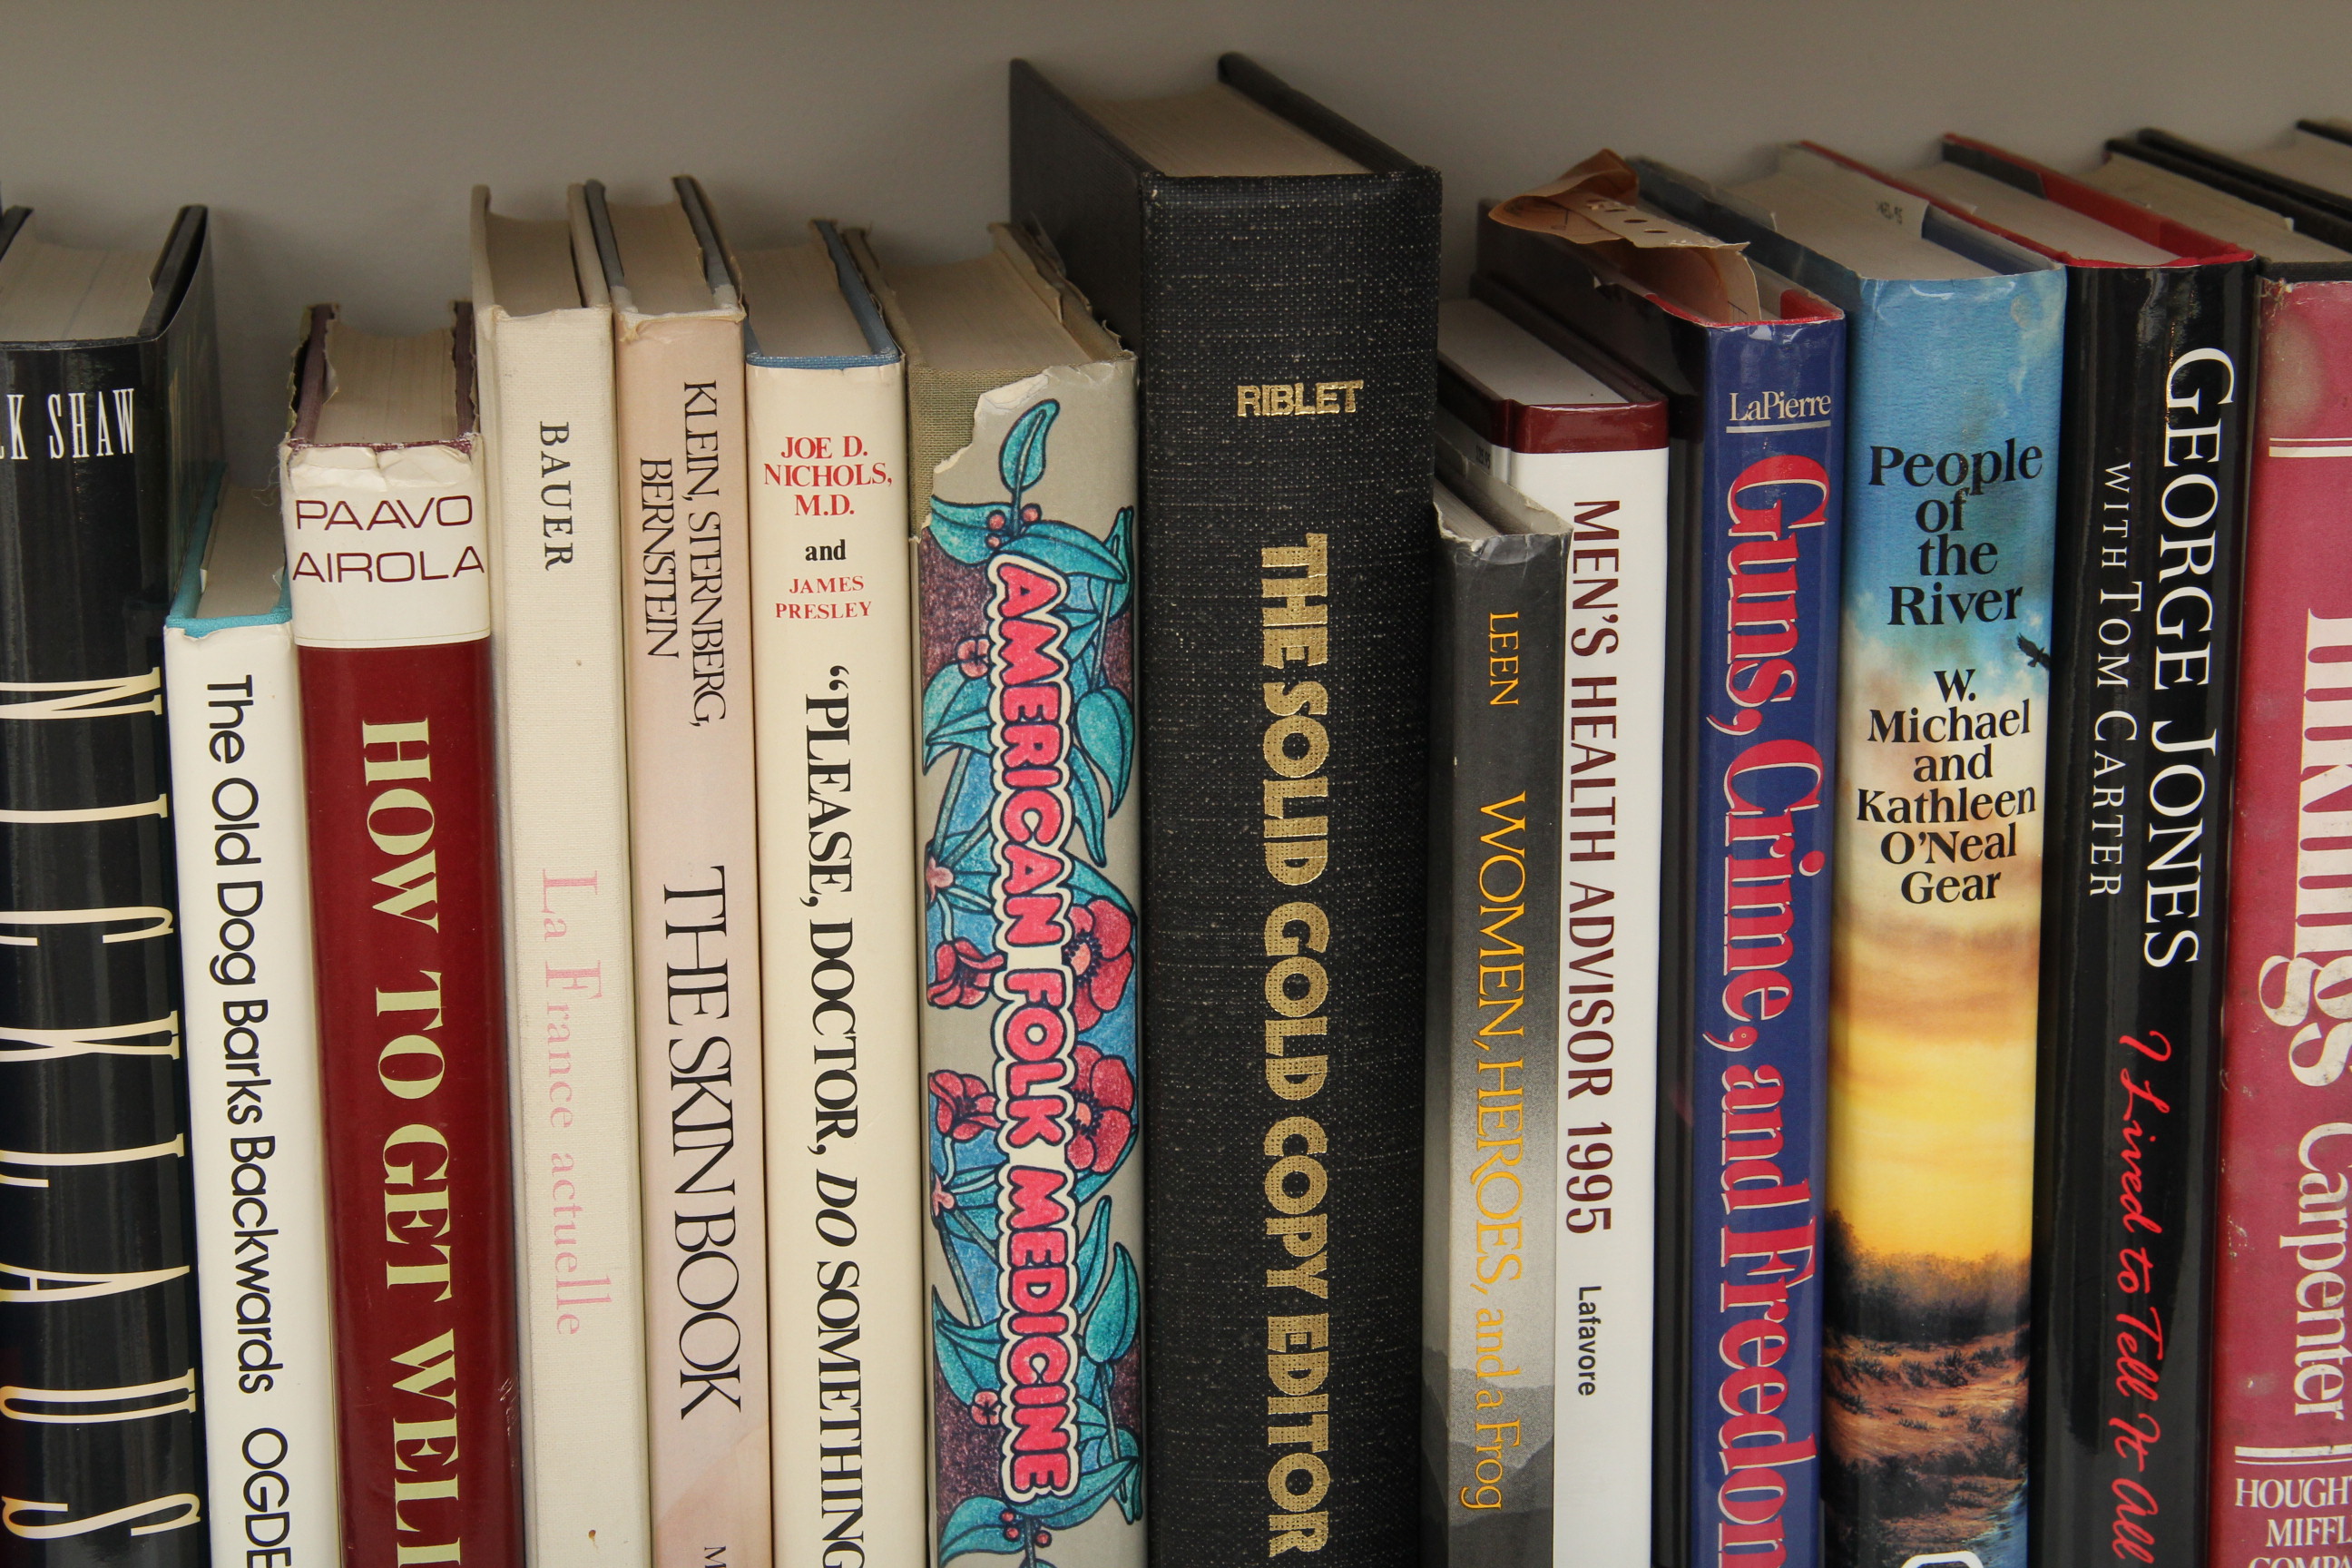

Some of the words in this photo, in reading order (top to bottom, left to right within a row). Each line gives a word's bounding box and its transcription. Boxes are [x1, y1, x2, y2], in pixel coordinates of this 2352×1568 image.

[0, 395, 28, 459] K
[48, 388, 133, 458] SHAW
[682, 381, 719, 501] KLEIN,
[781, 437, 832, 459] JOE
[844, 436, 867, 457] D.
[1238, 380, 1364, 417] RIBLET
[1730, 391, 1830, 421] LaPierre
[296, 495, 472, 530] PAAVO
[540, 421, 573, 571] BAUER
[765, 465, 892, 486] NICHOLS,
[796, 495, 855, 515] M.D.
[1868, 438, 2042, 495] People
[1916, 487, 1970, 533] of
[2102, 463, 2131, 567] WITH
[2155, 348, 2234, 690] GEORGE
[292, 546, 485, 583] AIROLA
[641, 458, 679, 658] BERNSTEIN
[789, 578, 864, 593] JAMES
[806, 539, 846, 561] and
[1261, 533, 1328, 669] THE
[1571, 501, 1620, 656] MEN’S
[1706, 454, 1830, 736] Guns,
[1887, 582, 2023, 625] River
[1918, 534, 1997, 575] the
[689, 512, 726, 726] STERNBERG,
[776, 603, 867, 619] PRESLEY
[1489, 612, 1519, 705] LEEN
[2097, 582, 2141, 688] TOM
[208, 675, 253, 763] The
[1867, 699, 2029, 742] Michael
[1934, 669, 1975, 702] W.
[998, 563, 1064, 947] AMERICAN
[1263, 681, 1329, 886] SOLID
[1570, 677, 1616, 861] HEALTH
[1857, 787, 2035, 823] Kathleen
[1914, 743, 1993, 782] and
[2091, 710, 2137, 895] CARTER
[212, 778, 261, 866] Old
[363, 718, 438, 933] HOW
[1881, 822, 2016, 864] O’Neal
[2144, 721, 2216, 967] JONES
[210, 881, 263, 985] Dog
[542, 870, 598, 941] La
[1473, 791, 1526, 1051] WOMEN,
[1702, 739, 1825, 1052] Crime,
[1901, 871, 2001, 904] Gear
[664, 866, 729, 1025] THE
[1568, 882, 1614, 1099] ADVISOR
[377, 970, 445, 1099] TO
[545, 960, 603, 1129] France
[808, 918, 858, 1154] DOCTOR,
[1264, 902, 1329, 1100] GOLD
[0, 667, 201, 1540] NICKLAUS
[223, 1000, 271, 1124] Barks
[1004, 969, 1066, 1148] FOLK
[669, 1036, 735, 1195] SKIN
[1721, 1064, 1812, 1210] and
[2120, 1069, 2171, 1233] Lived
[383, 1124, 452, 1302] GET
[816, 1169, 857, 1247] DO
[1262, 1116, 1328, 1298] COPY
[1471, 1058, 1524, 1295] HEROES,
[1566, 1122, 1612, 1233] 1995
[230, 1136, 283, 1393] Backwards
[552, 1154, 612, 1334] actuelle
[2117, 1247, 2154, 1293] to
[2279, 1122, 2352, 1420] Carpenter
[675, 1206, 740, 1419] BOOK
[1007, 1166, 1072, 1492] MEDICINE
[1476, 1308, 1521, 1379] and
[1578, 1287, 1602, 1396] Lafavore
[2116, 1307, 2163, 1401] Tell
[818, 1261, 865, 1568] SOMETHING
[1268, 1313, 1330, 1557] EDITOR
[1475, 1390, 1498, 1411] a
[2108, 1413, 2161, 1472] It
[1460, 1419, 1521, 1510] Frog
[2236, 1475, 2352, 1508] HOUGH
[2112, 1478, 2159, 1563] All
[2266, 1516, 2352, 1546] MIFFL
